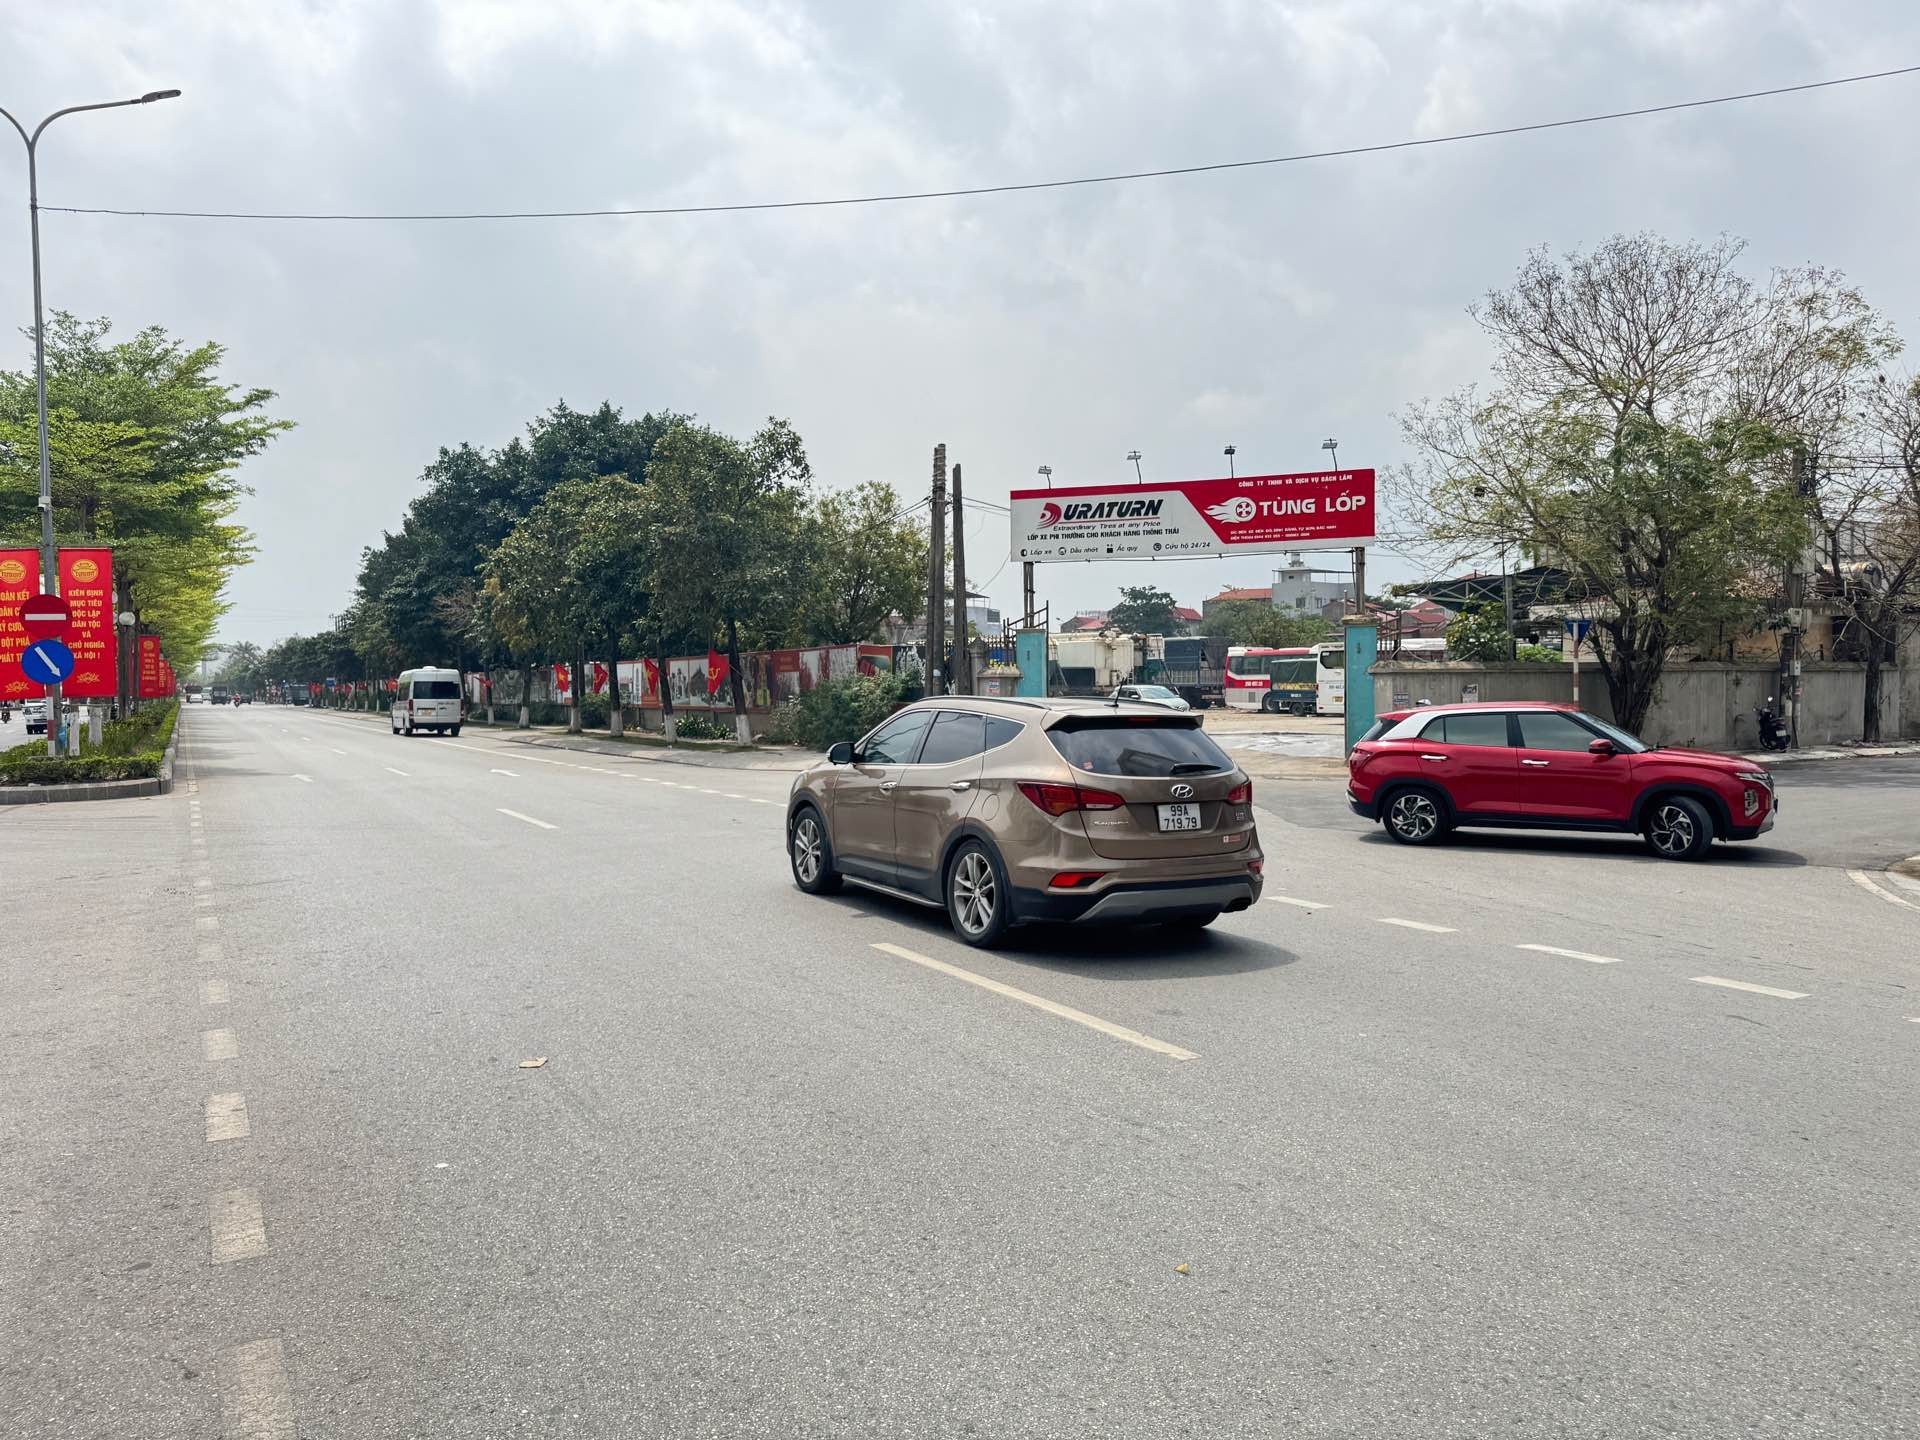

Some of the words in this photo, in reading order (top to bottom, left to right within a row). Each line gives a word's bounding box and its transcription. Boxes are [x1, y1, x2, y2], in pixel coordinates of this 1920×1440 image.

[1259, 496, 1315, 516] TÙNG
[1325, 490, 1366, 513] LỐP
[1053, 523, 1096, 531] Extraordinary
[1170, 805, 1189, 817] 99A
[1164, 817, 1197, 830] 719.79
